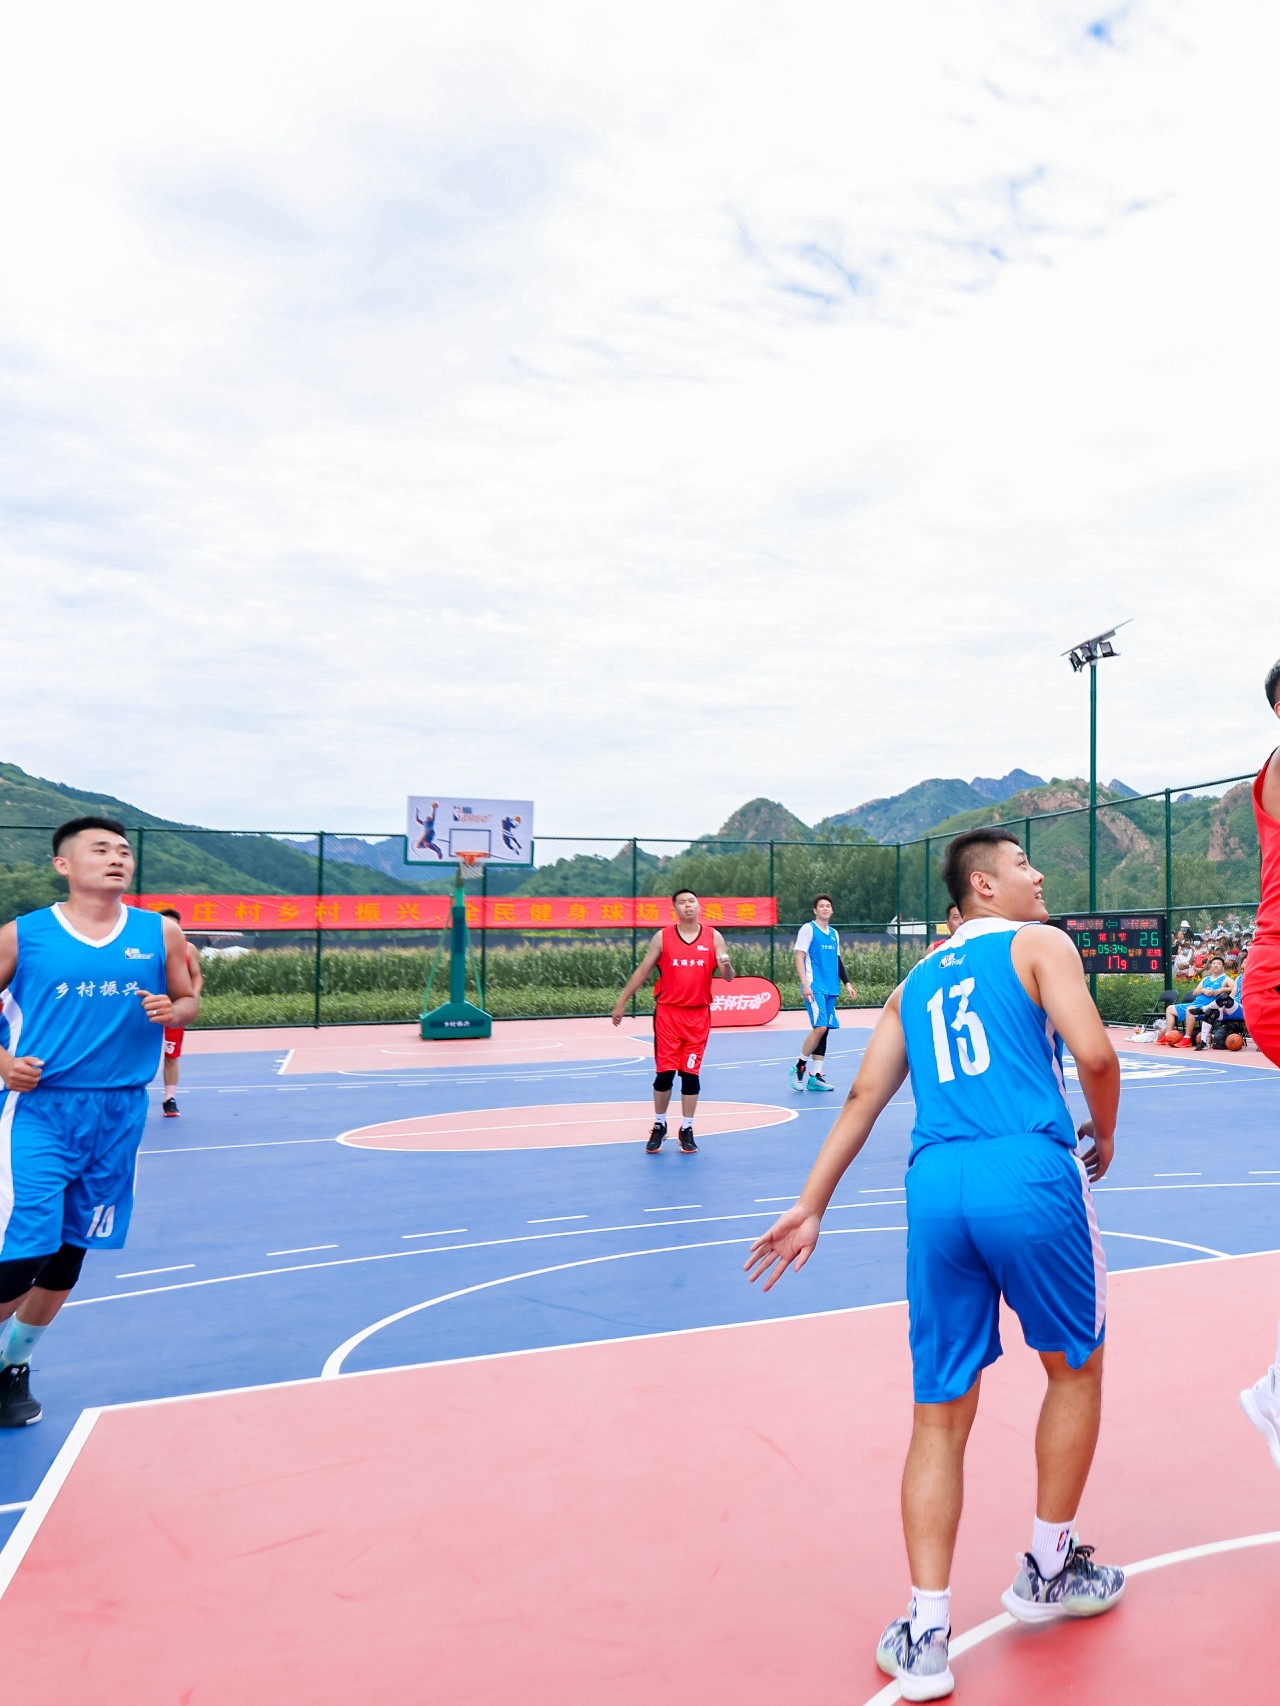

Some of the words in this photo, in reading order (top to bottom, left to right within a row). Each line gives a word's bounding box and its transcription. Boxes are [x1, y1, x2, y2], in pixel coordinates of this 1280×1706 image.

[1140, 932, 1159, 946] 26
[56, 980, 140, 1000] 乡村振兴
[926, 976, 991, 1084] 13
[686, 1052, 698, 1070] 6
[86, 1204, 116, 1238] 10
